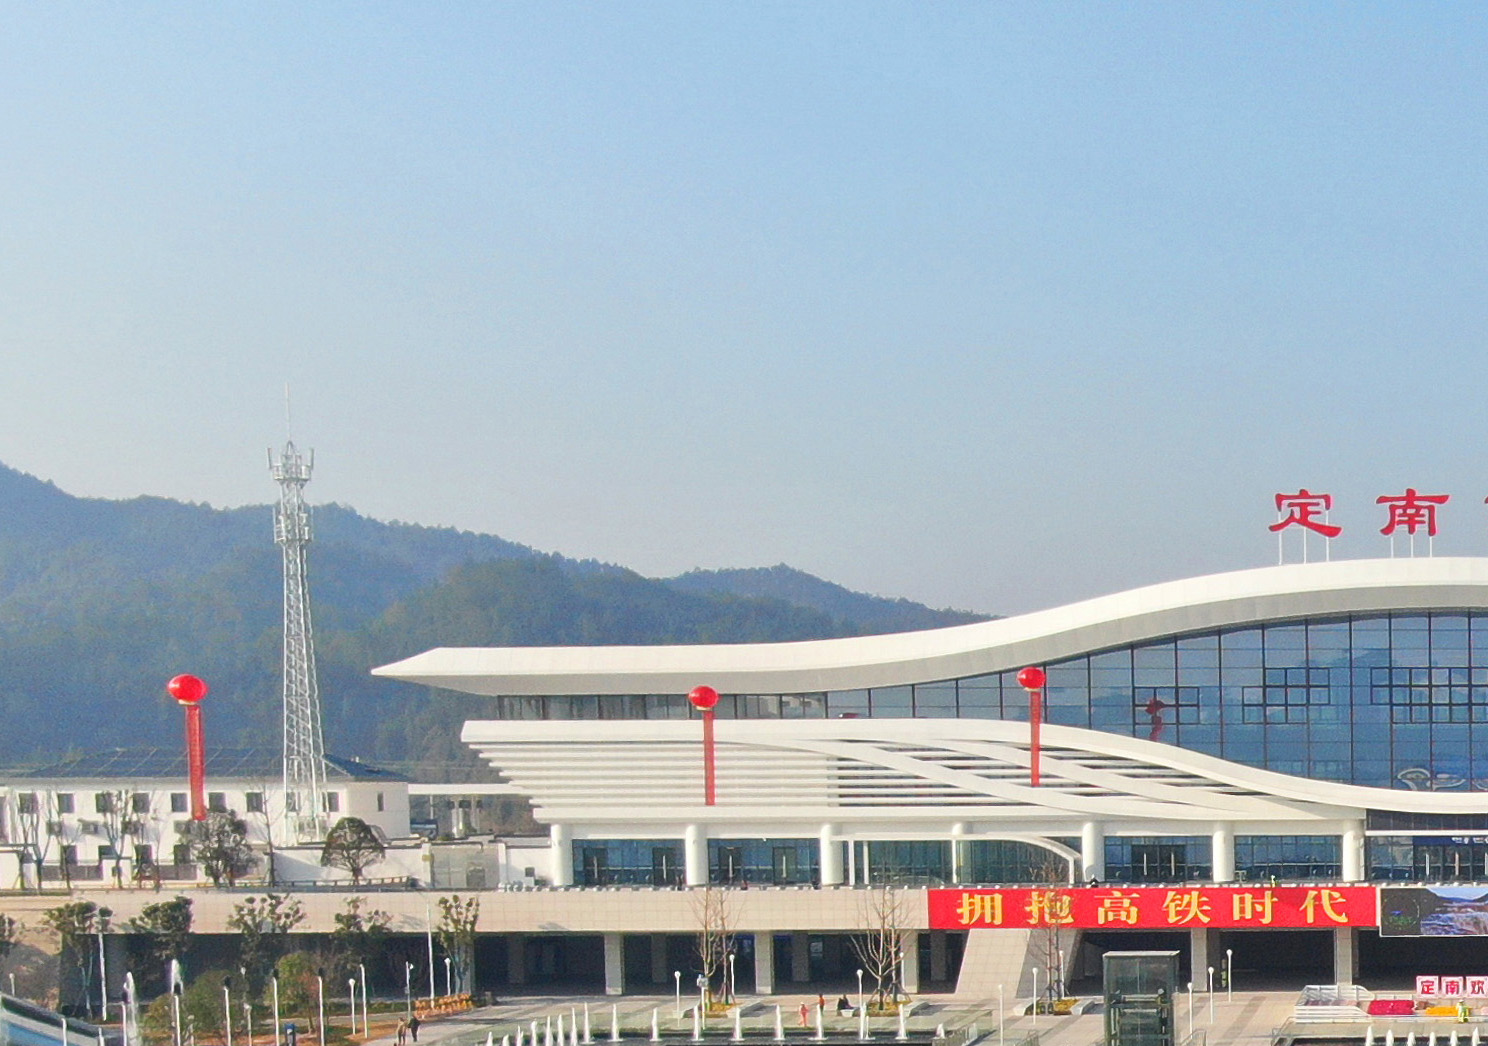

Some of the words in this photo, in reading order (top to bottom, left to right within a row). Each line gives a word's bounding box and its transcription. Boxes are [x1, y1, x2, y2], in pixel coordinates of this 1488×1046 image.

[956, 891, 1348, 925] 拥抱高铁时代
